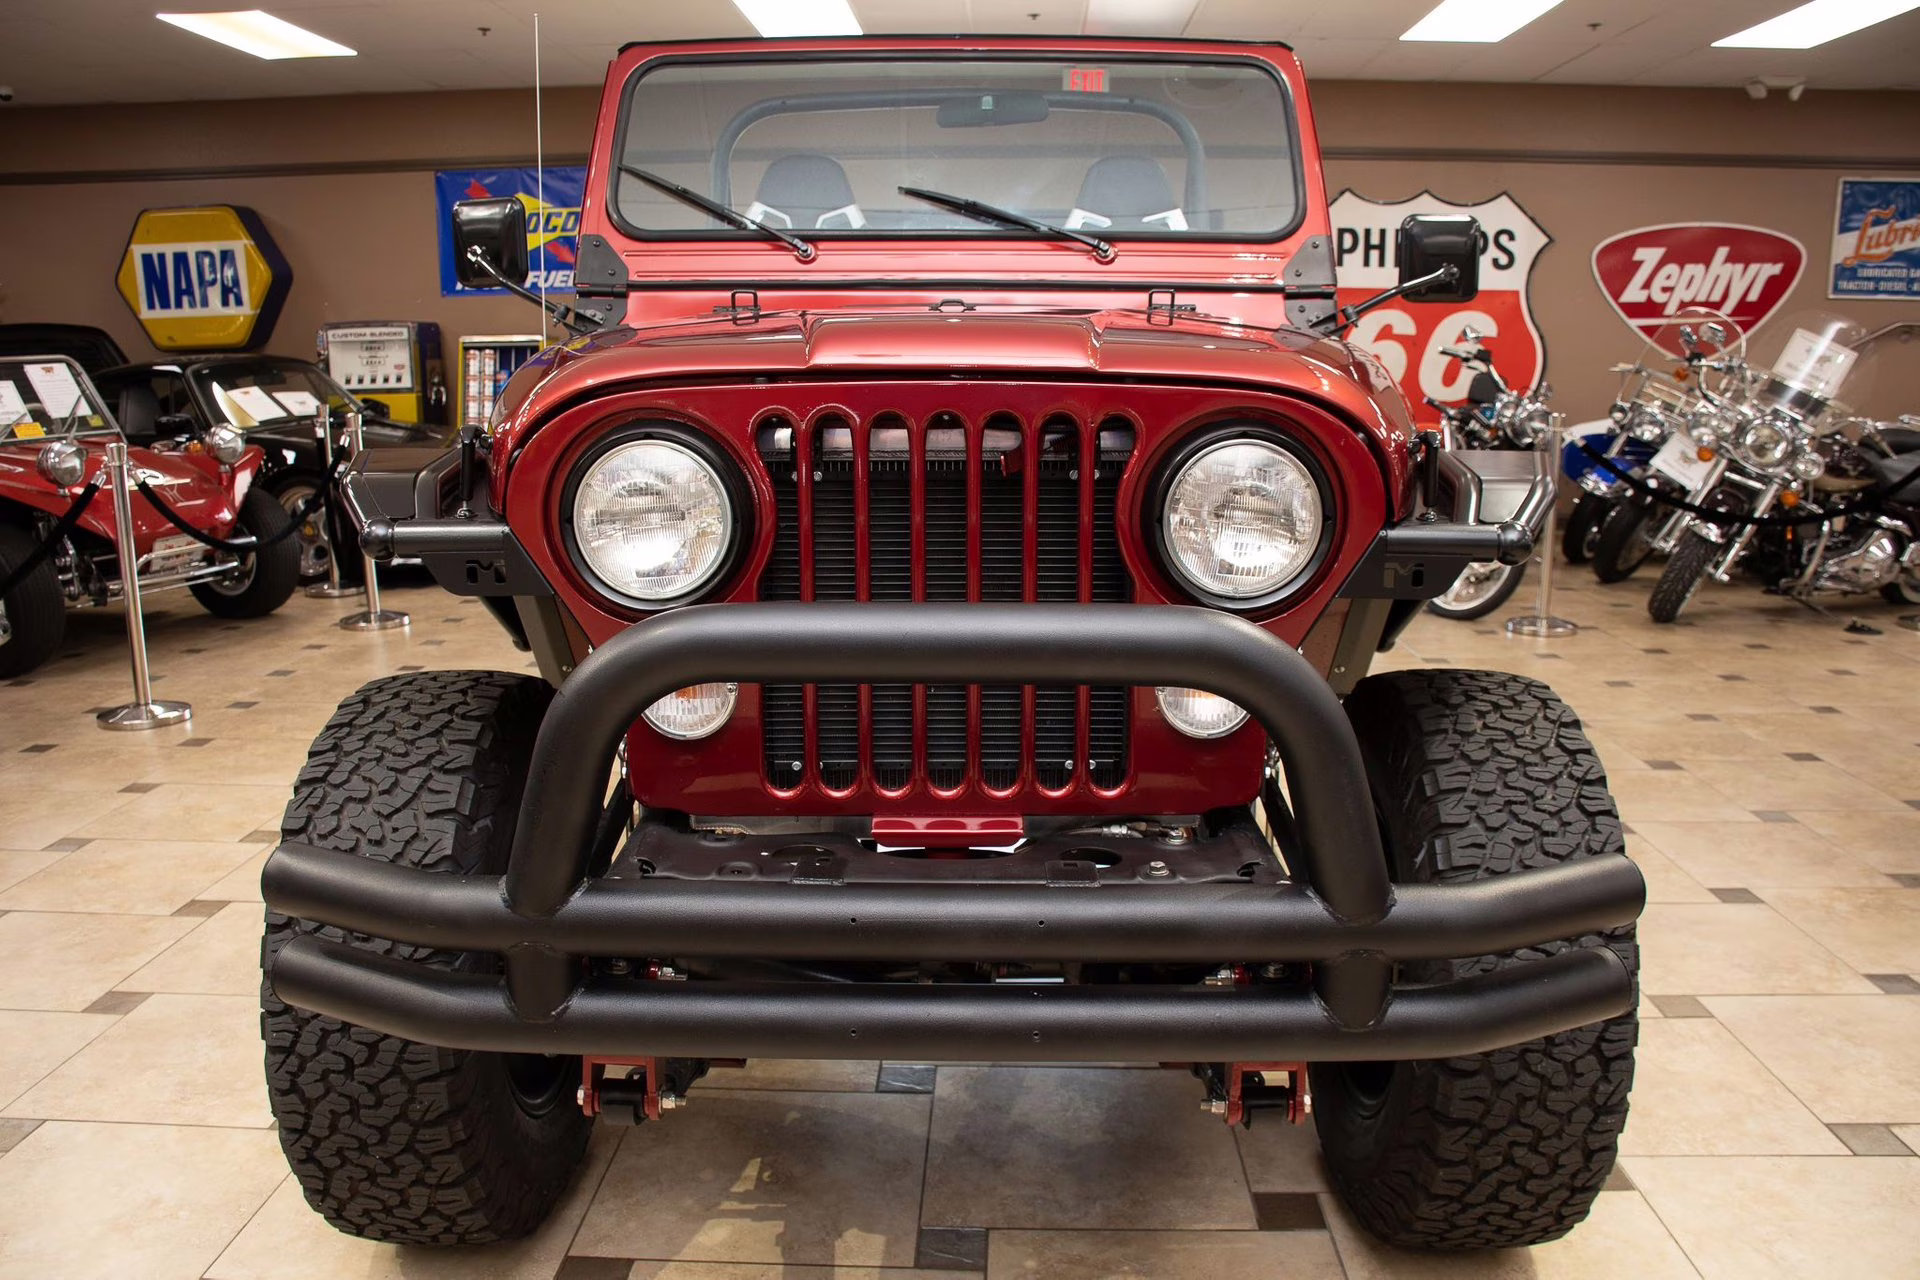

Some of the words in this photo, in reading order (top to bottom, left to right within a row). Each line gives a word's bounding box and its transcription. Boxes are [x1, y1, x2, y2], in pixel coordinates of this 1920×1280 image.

[1071, 69, 1104, 92] EXIT
[527, 212, 580, 233] OCO
[1337, 228, 1516, 271] PHIS
[141, 249, 244, 310] NAPA
[1618, 246, 1784, 315] Zephyr
[1345, 309, 1498, 402] 66
